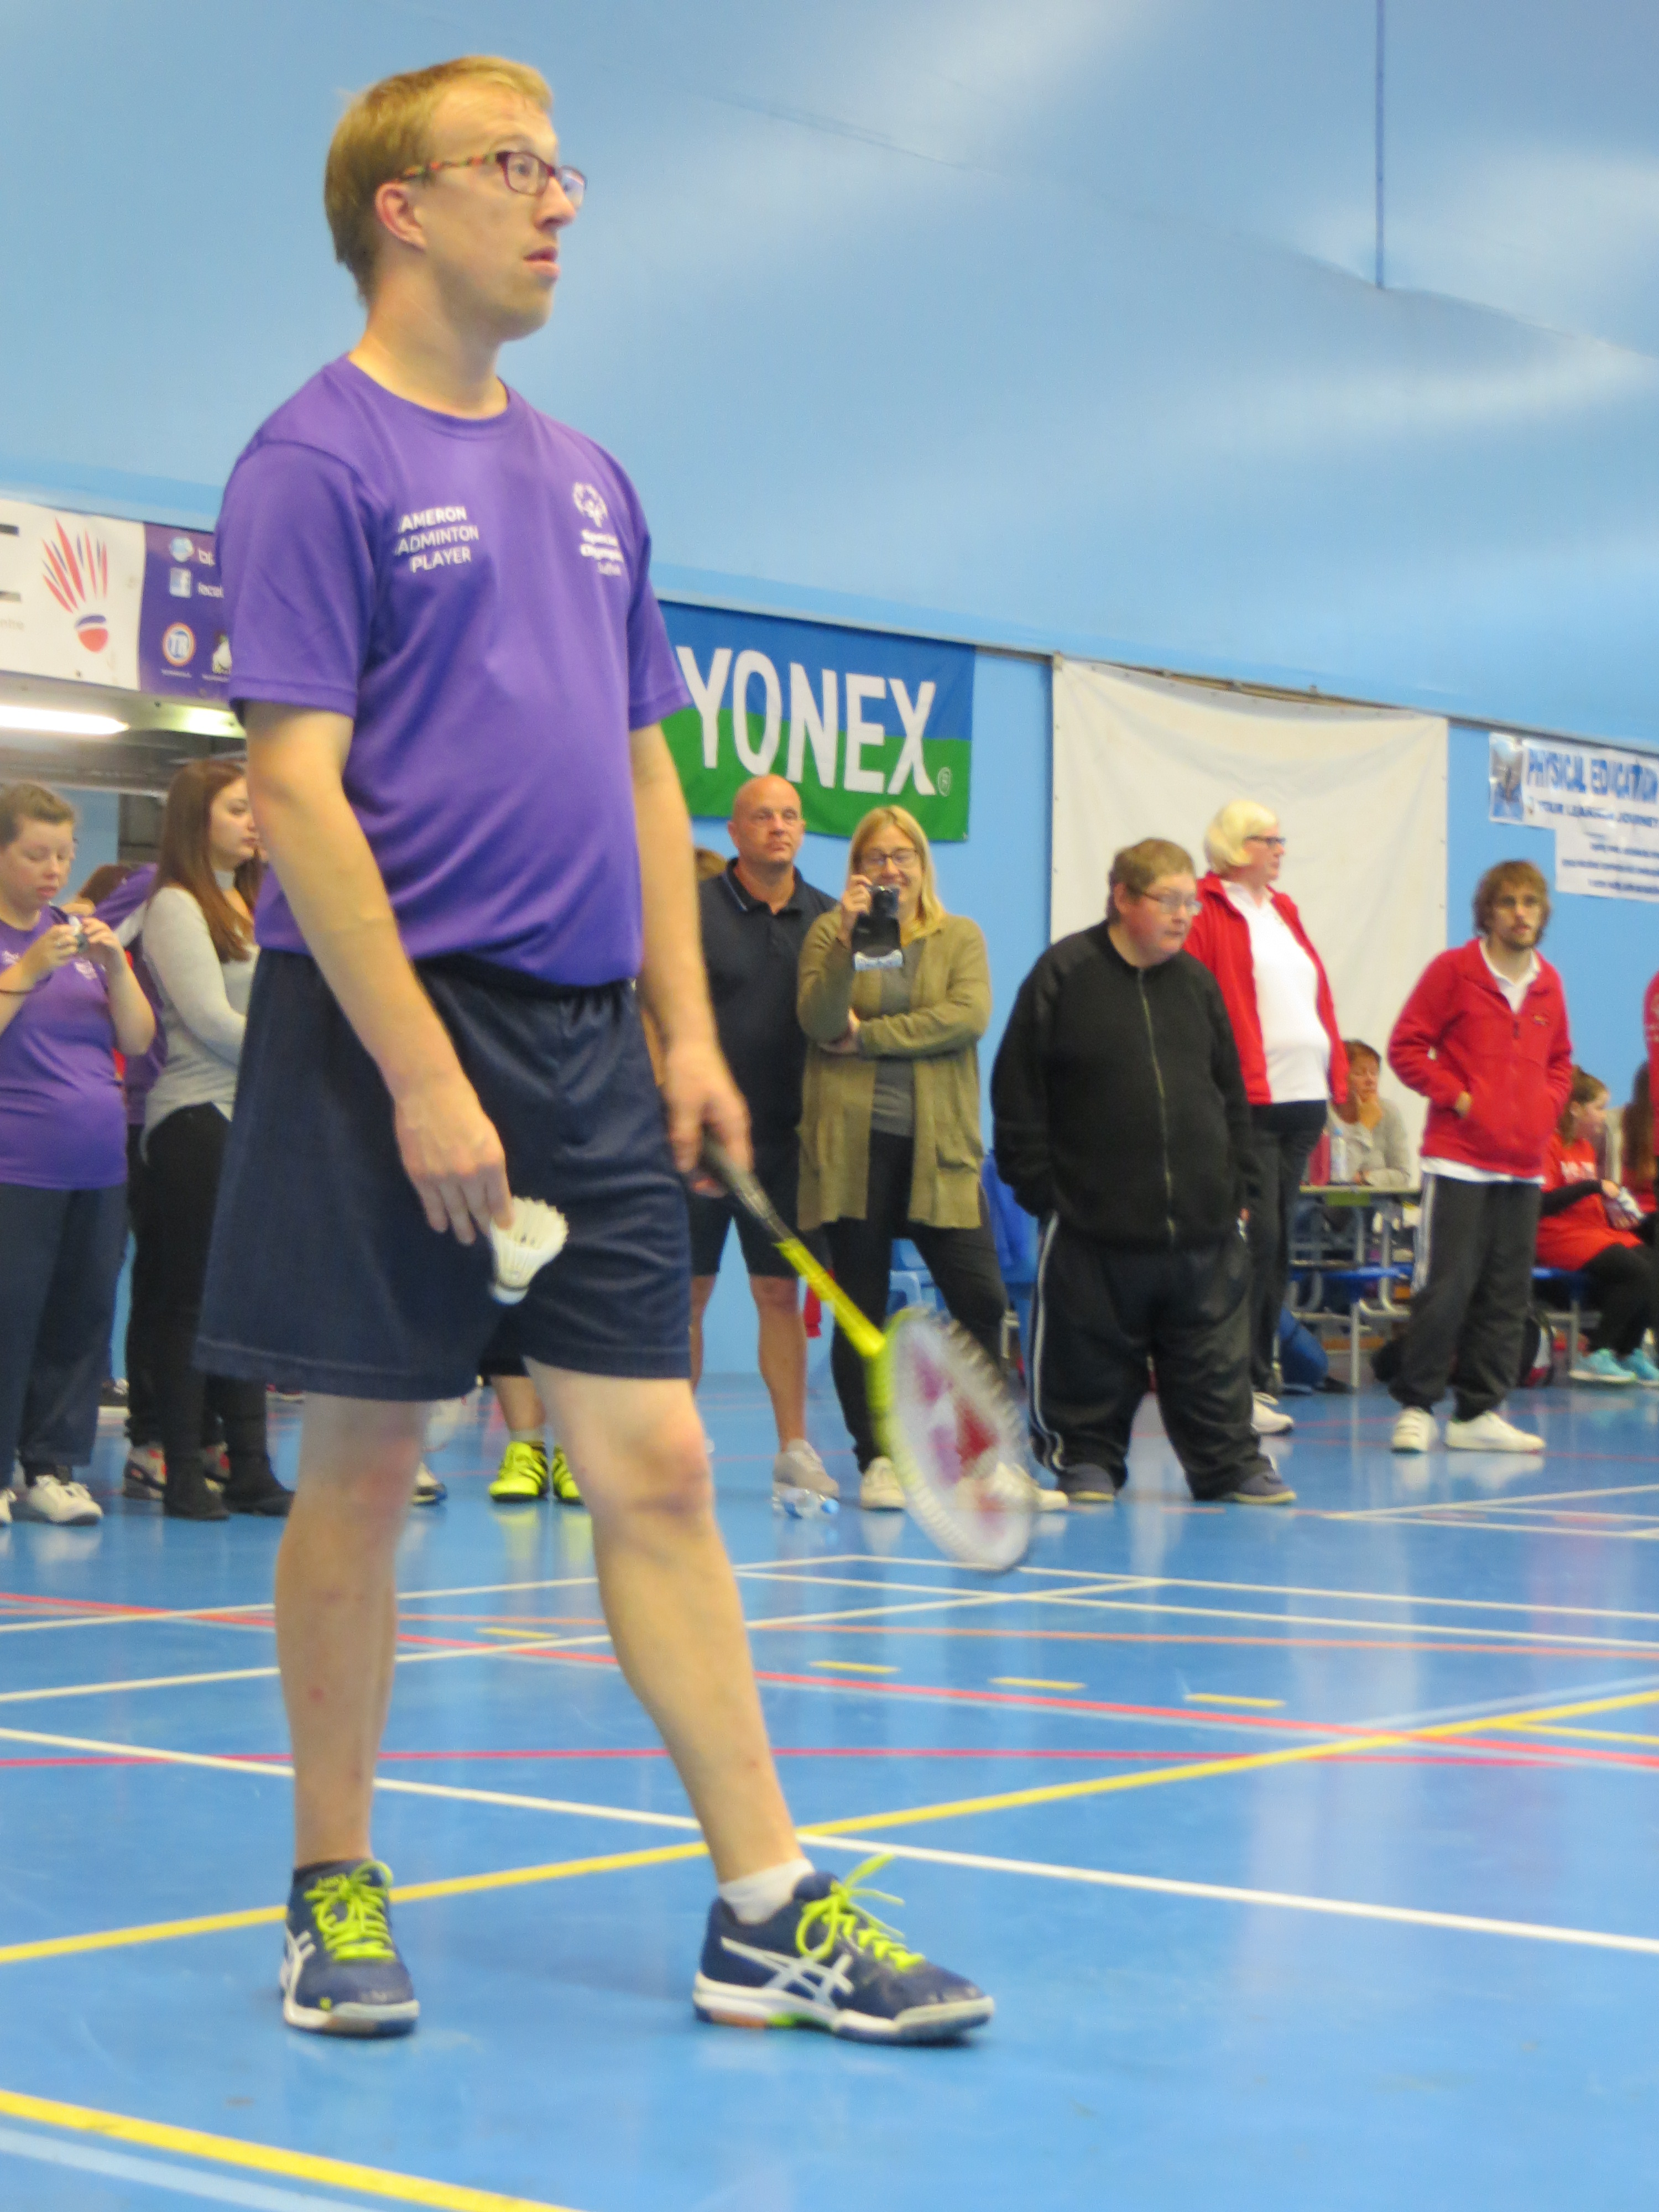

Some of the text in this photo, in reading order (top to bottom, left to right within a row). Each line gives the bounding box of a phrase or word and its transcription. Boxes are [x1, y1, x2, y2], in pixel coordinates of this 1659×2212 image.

[399, 506, 467, 533] AMERON
[395, 526, 479, 556] ADMINTON
[410, 545, 472, 573] PLAYER
[676, 646, 936, 796] YONEX
